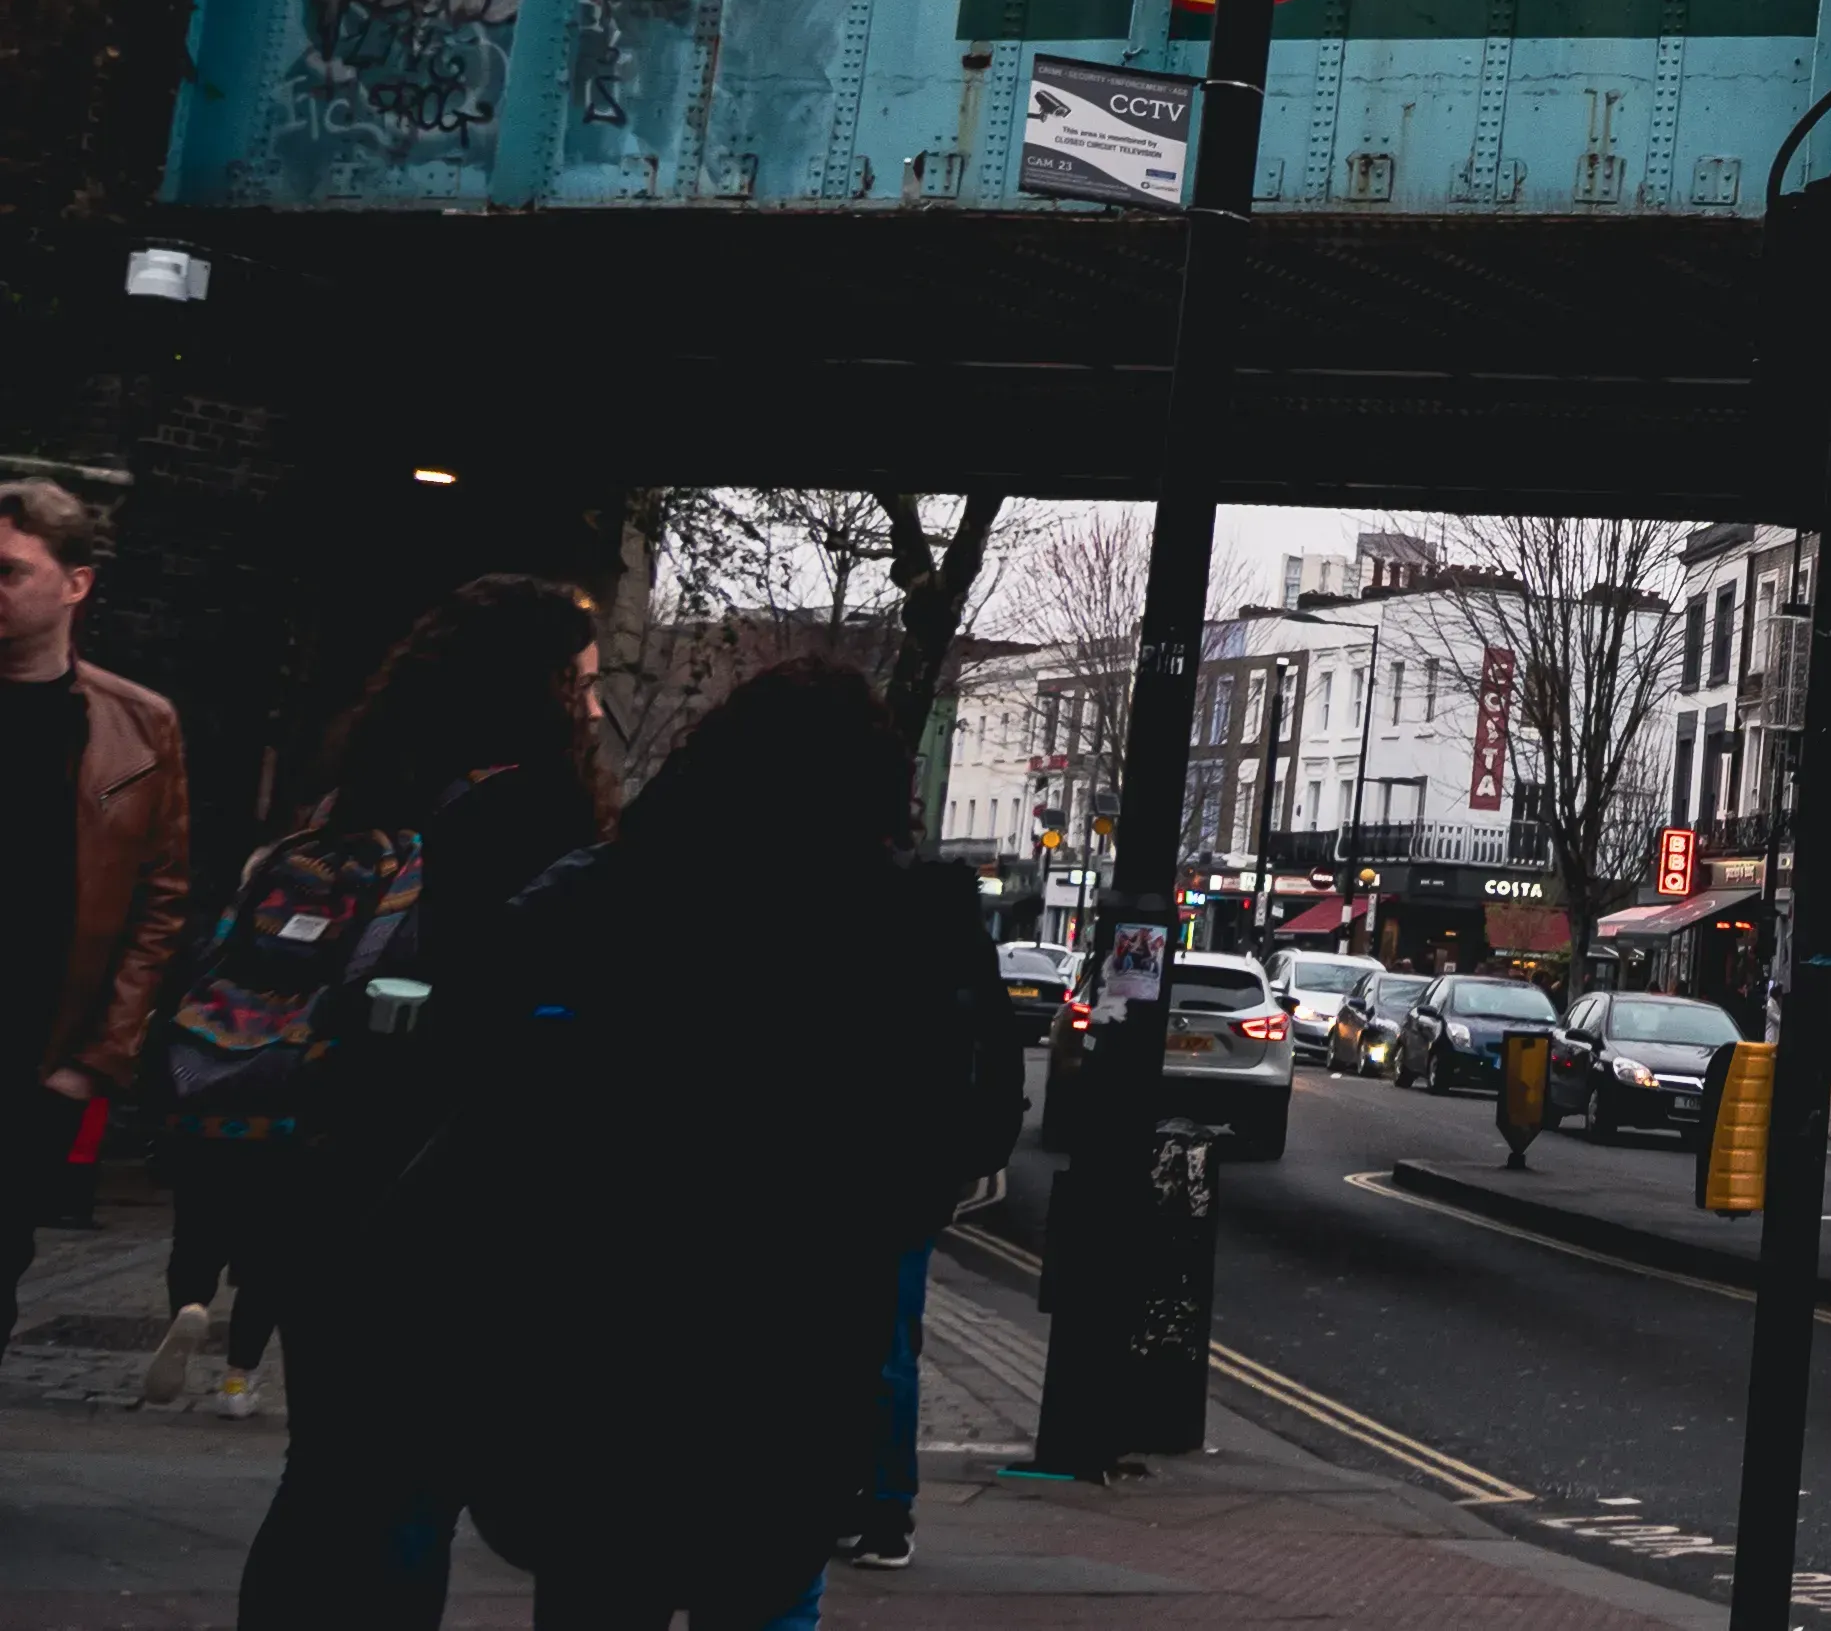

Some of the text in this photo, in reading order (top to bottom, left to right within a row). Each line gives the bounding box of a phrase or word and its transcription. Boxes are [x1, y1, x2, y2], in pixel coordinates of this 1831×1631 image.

[1109, 94, 1186, 122] CCTV
[1054, 135, 1086, 147] CLOSED
[1119, 145, 1163, 159] TELEVISION
[1062, 125, 1079, 136] This
[1080, 129, 1098, 139] area
[1106, 133, 1147, 146] monitored
[1147, 139, 1158, 150] by
[1027, 155, 1073, 171] CAM 23
[1664, 835, 1686, 890] BBQ
[1484, 879, 1543, 898] COSTA
